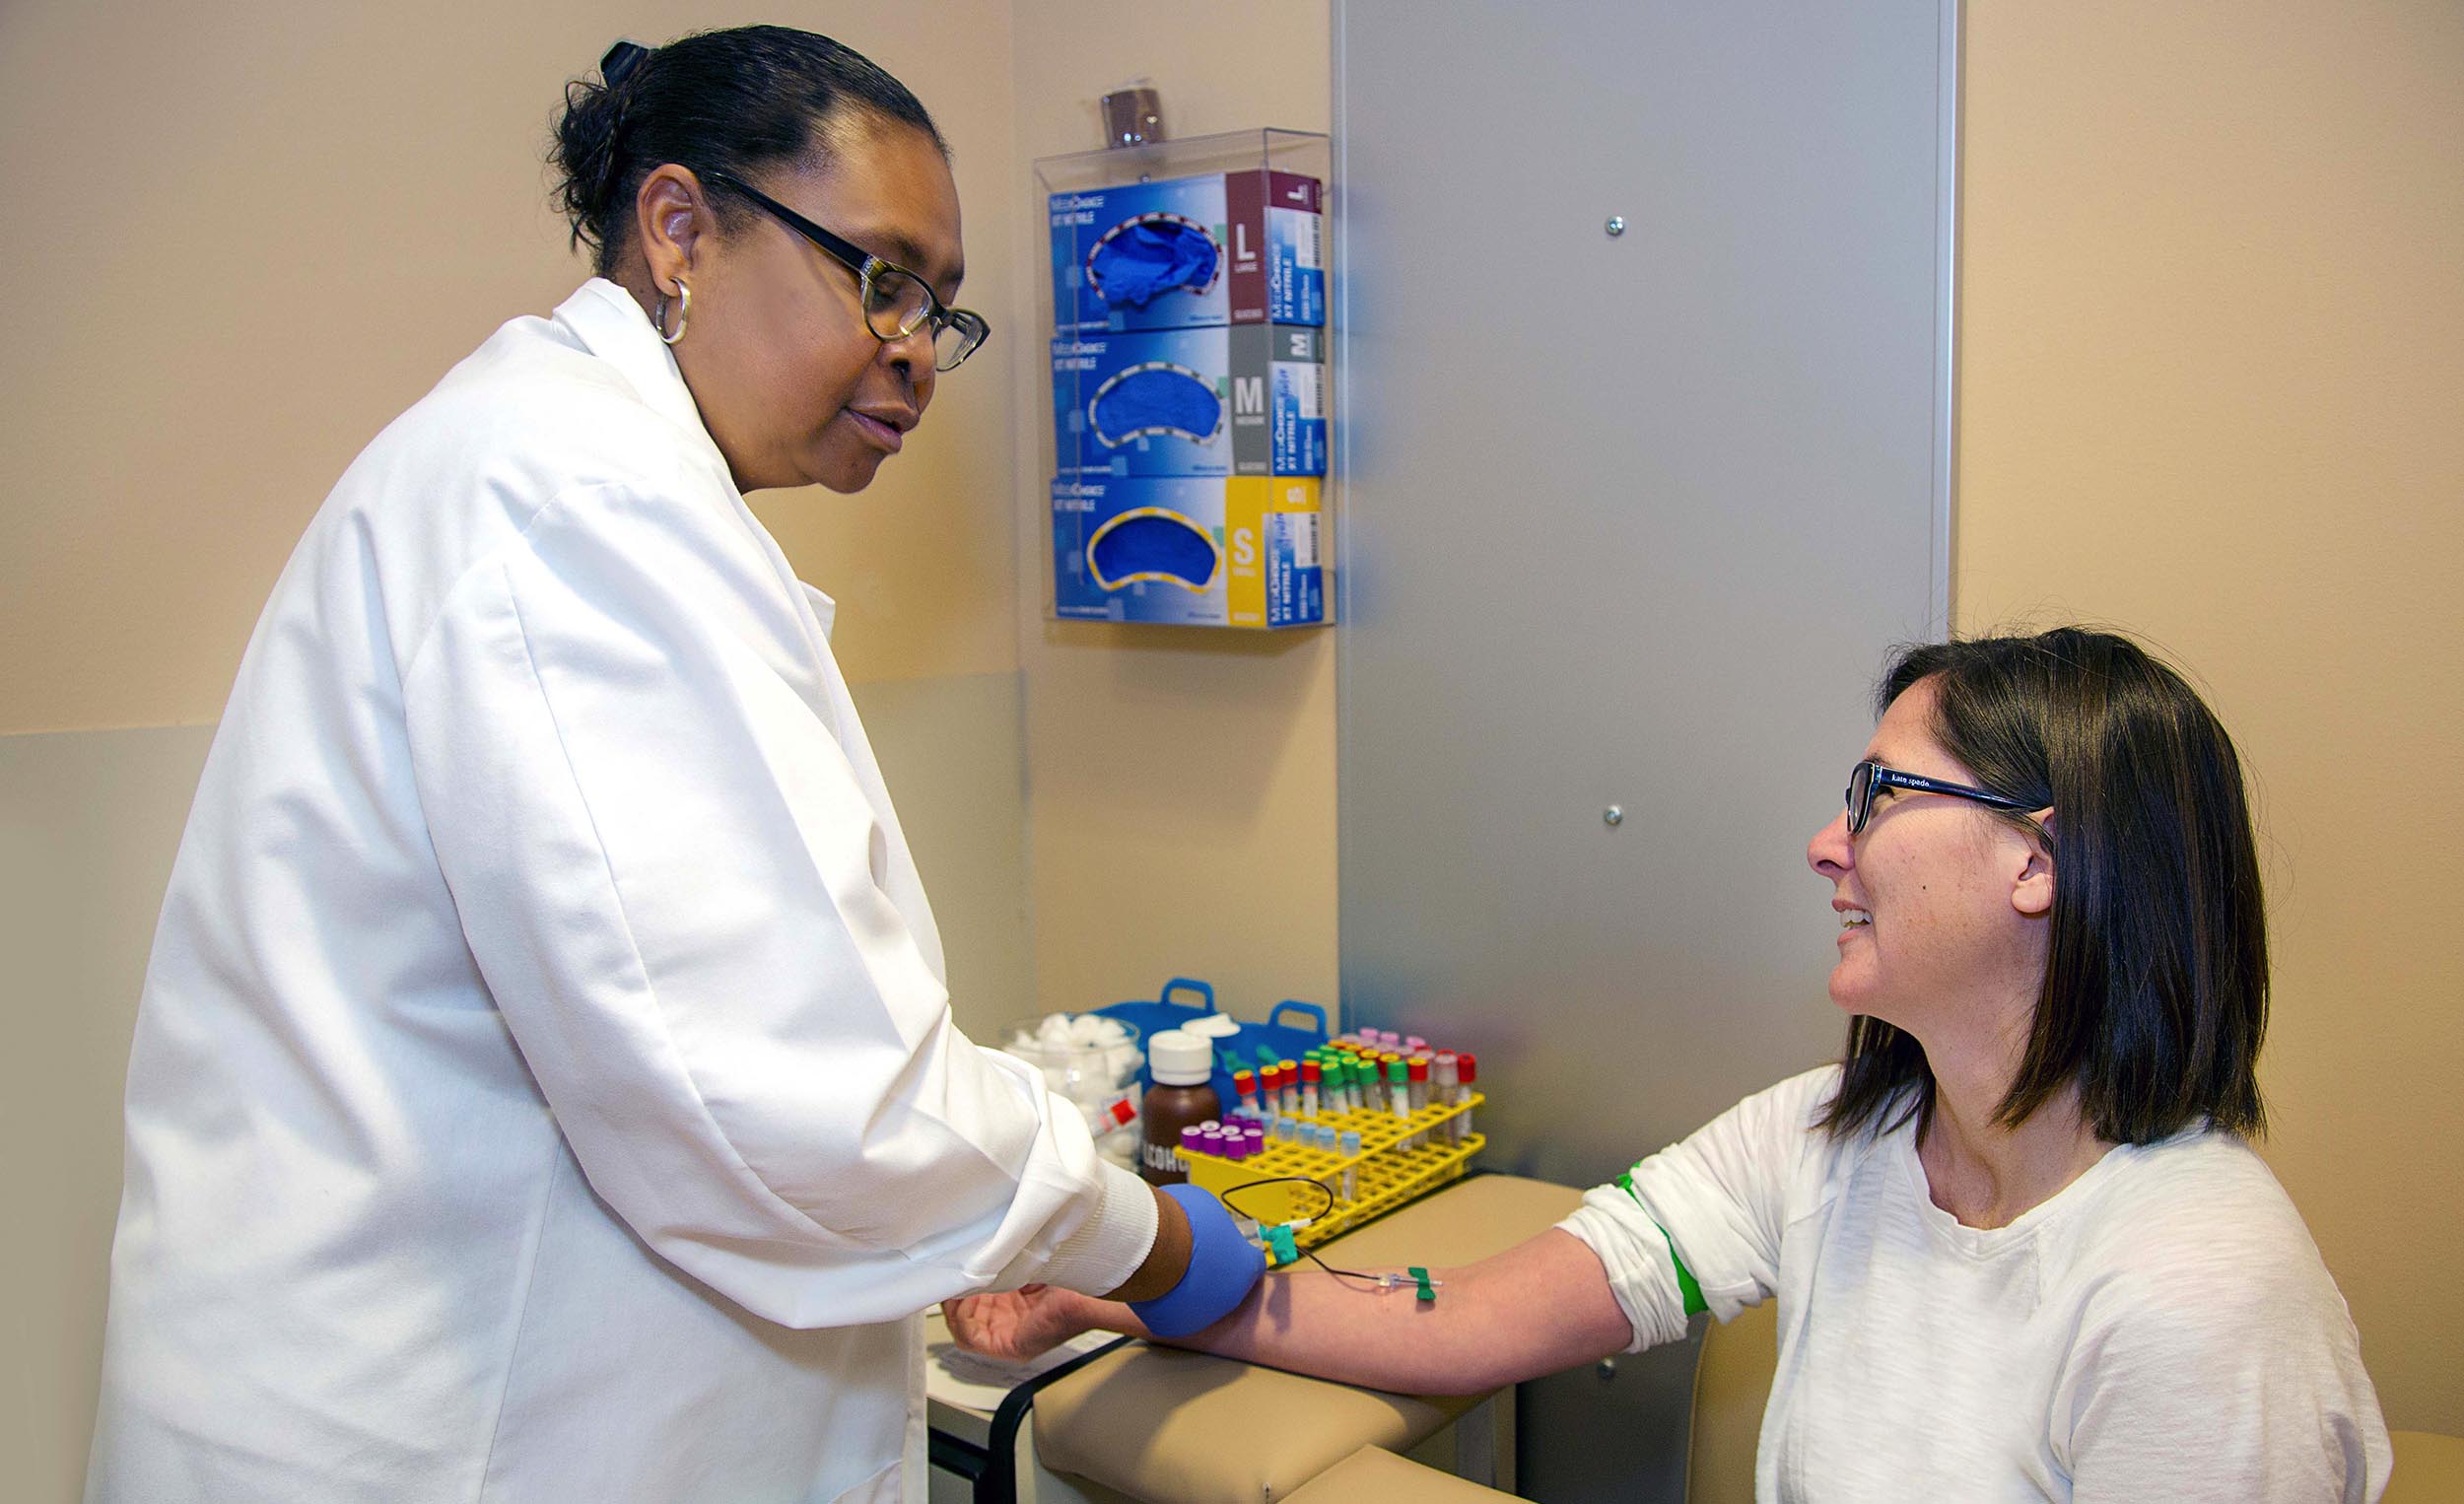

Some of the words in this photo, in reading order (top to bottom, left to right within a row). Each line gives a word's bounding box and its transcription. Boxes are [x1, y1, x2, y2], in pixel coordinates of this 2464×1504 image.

[1236, 224, 1256, 261] L
[1290, 333, 1308, 357] M
[1235, 376, 1264, 415] M
[1233, 527, 1255, 566] S
[1892, 774, 1907, 784] kate
[1908, 779, 1930, 787] spade
